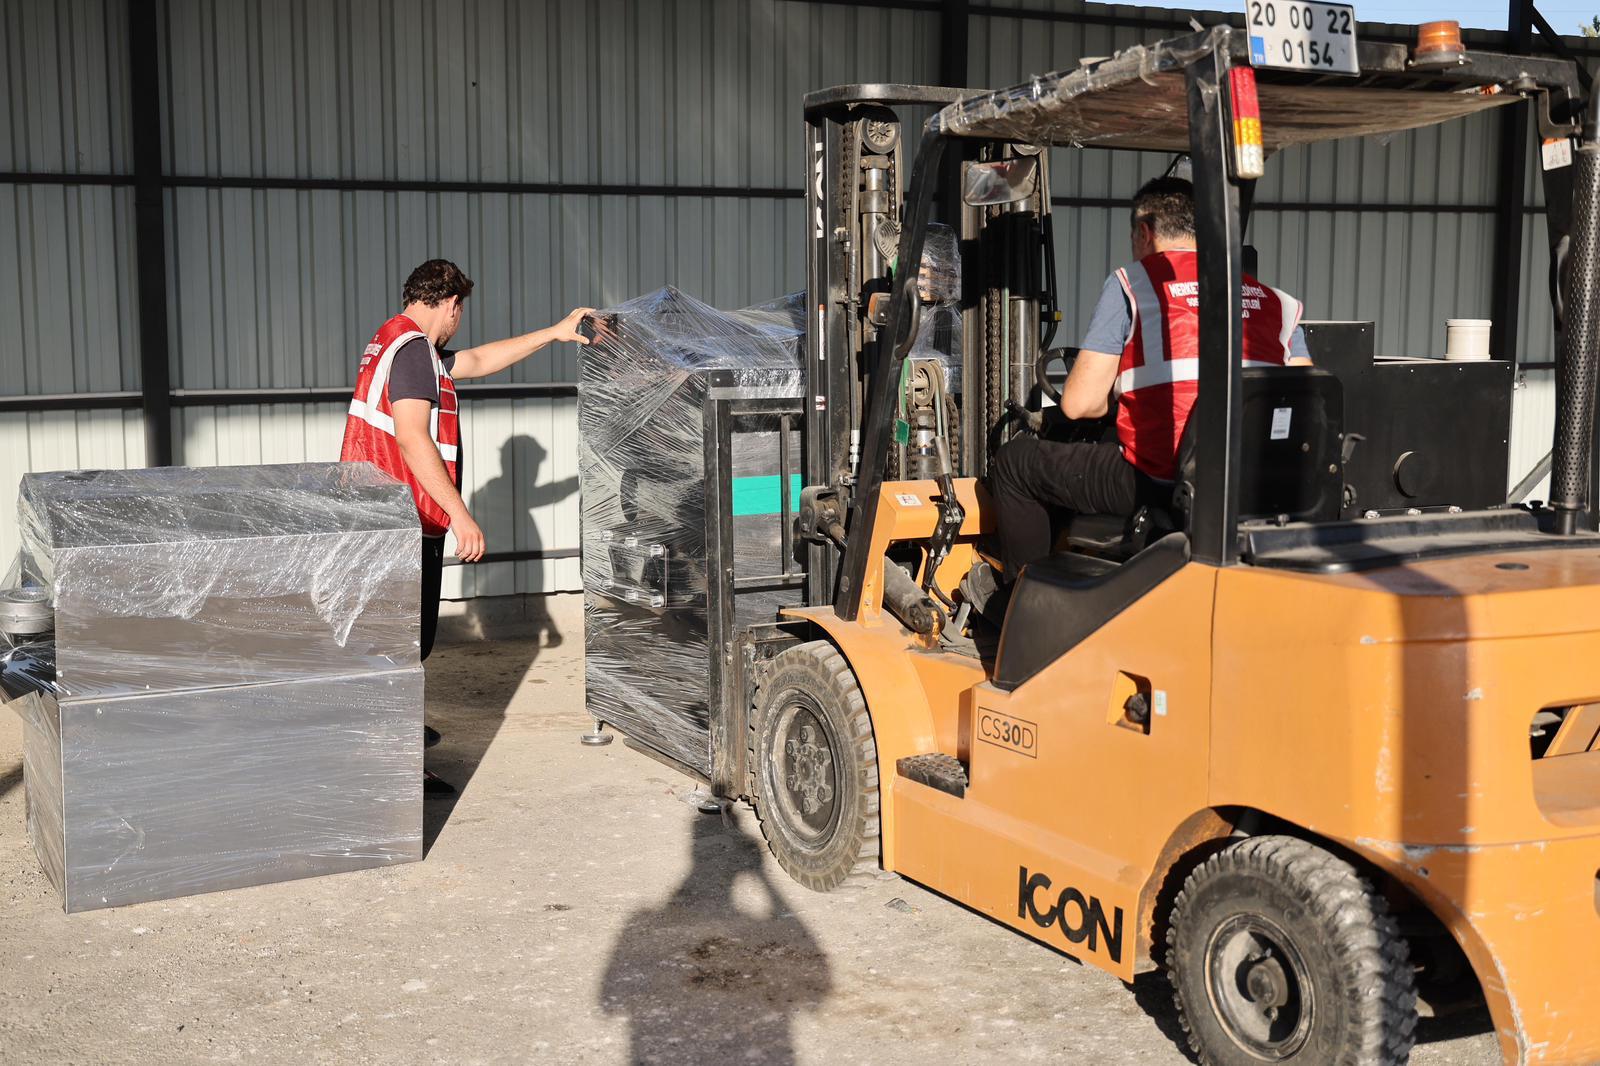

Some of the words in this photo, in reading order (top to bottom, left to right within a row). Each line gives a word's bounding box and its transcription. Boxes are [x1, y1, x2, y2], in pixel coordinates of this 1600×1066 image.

[1252, 1, 1276, 26] 20
[1290, 6, 1313, 30] 00
[1327, 9, 1352, 35] 22
[1282, 39, 1334, 67] 0154
[981, 715, 1034, 749] CS30D
[1017, 865, 1123, 964] ICON
